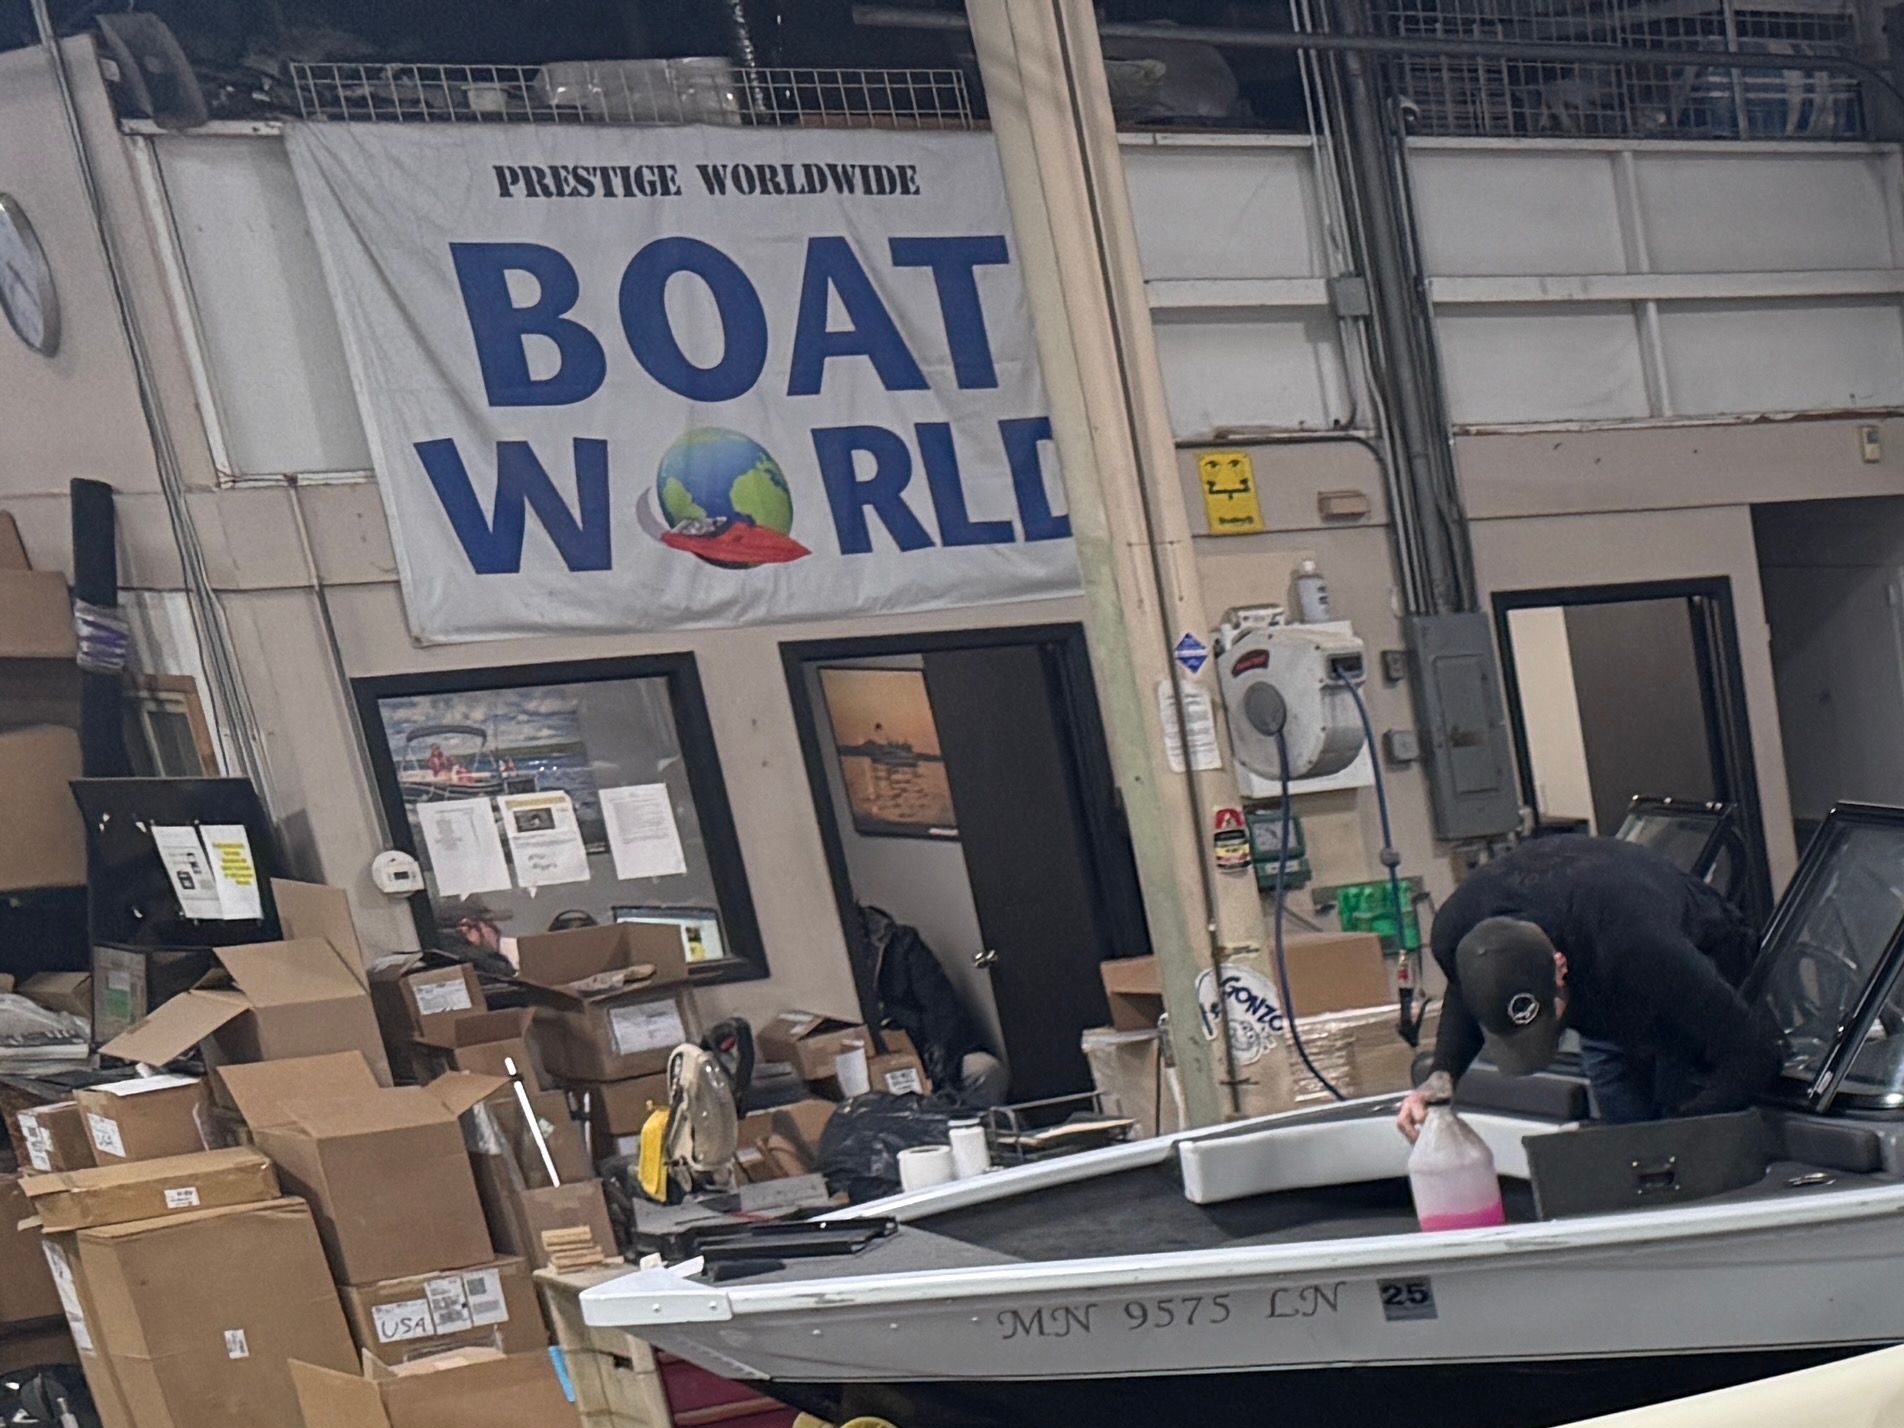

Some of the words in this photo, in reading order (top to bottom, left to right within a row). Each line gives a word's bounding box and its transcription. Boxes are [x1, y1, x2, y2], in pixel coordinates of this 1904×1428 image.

[493, 164, 682, 198] PRESTIGE
[695, 163, 921, 197] WORLDWIDE
[449, 236, 1010, 407] BOAT
[997, 1303, 1098, 1340] MN
[1123, 1293, 1232, 1332] 9575
[1265, 1281, 1348, 1319] LN
[1381, 1282, 1431, 1307] 25
[381, 1317, 427, 1340] USA
